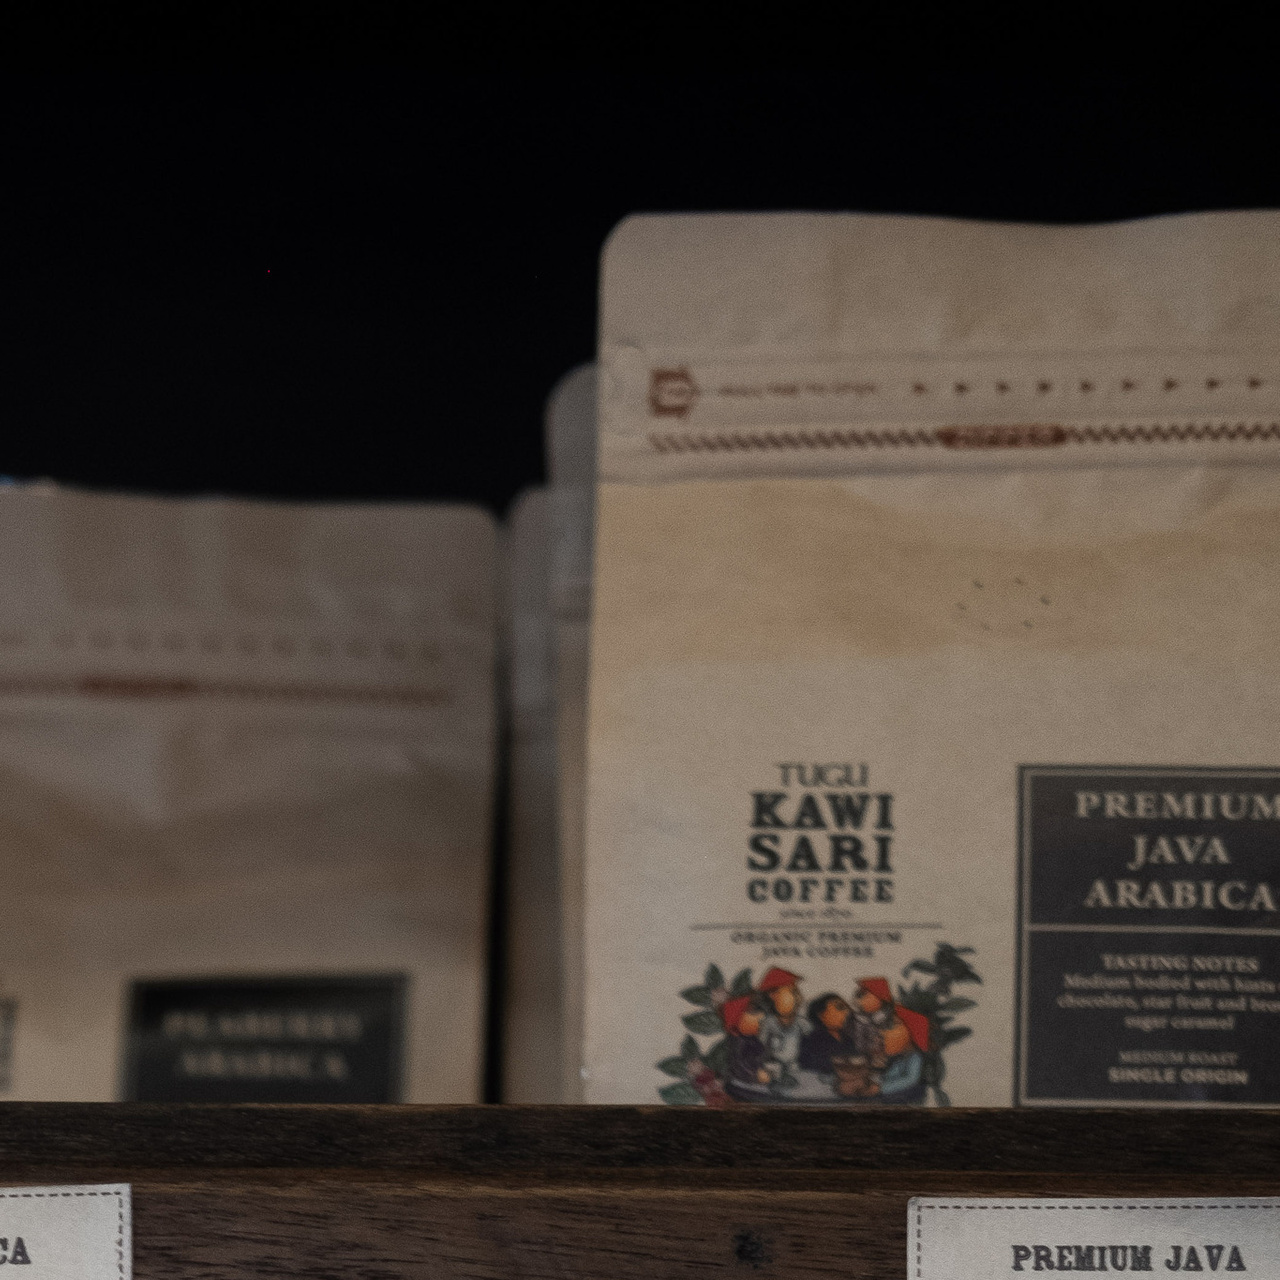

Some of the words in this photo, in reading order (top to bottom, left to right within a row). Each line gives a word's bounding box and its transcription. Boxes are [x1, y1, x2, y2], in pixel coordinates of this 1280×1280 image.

[777, 762, 869, 788] TUGU
[750, 791, 895, 831] KAWI
[1076, 790, 1280, 820] PREMIUM
[747, 833, 893, 874] SARI
[1127, 834, 1231, 871] JAVA
[747, 879, 895, 903] COFFEE
[1084, 878, 1278, 911] ARABICA
[1011, 1245, 1153, 1272] PREMIUM
[1164, 1245, 1246, 1272] JAVA
